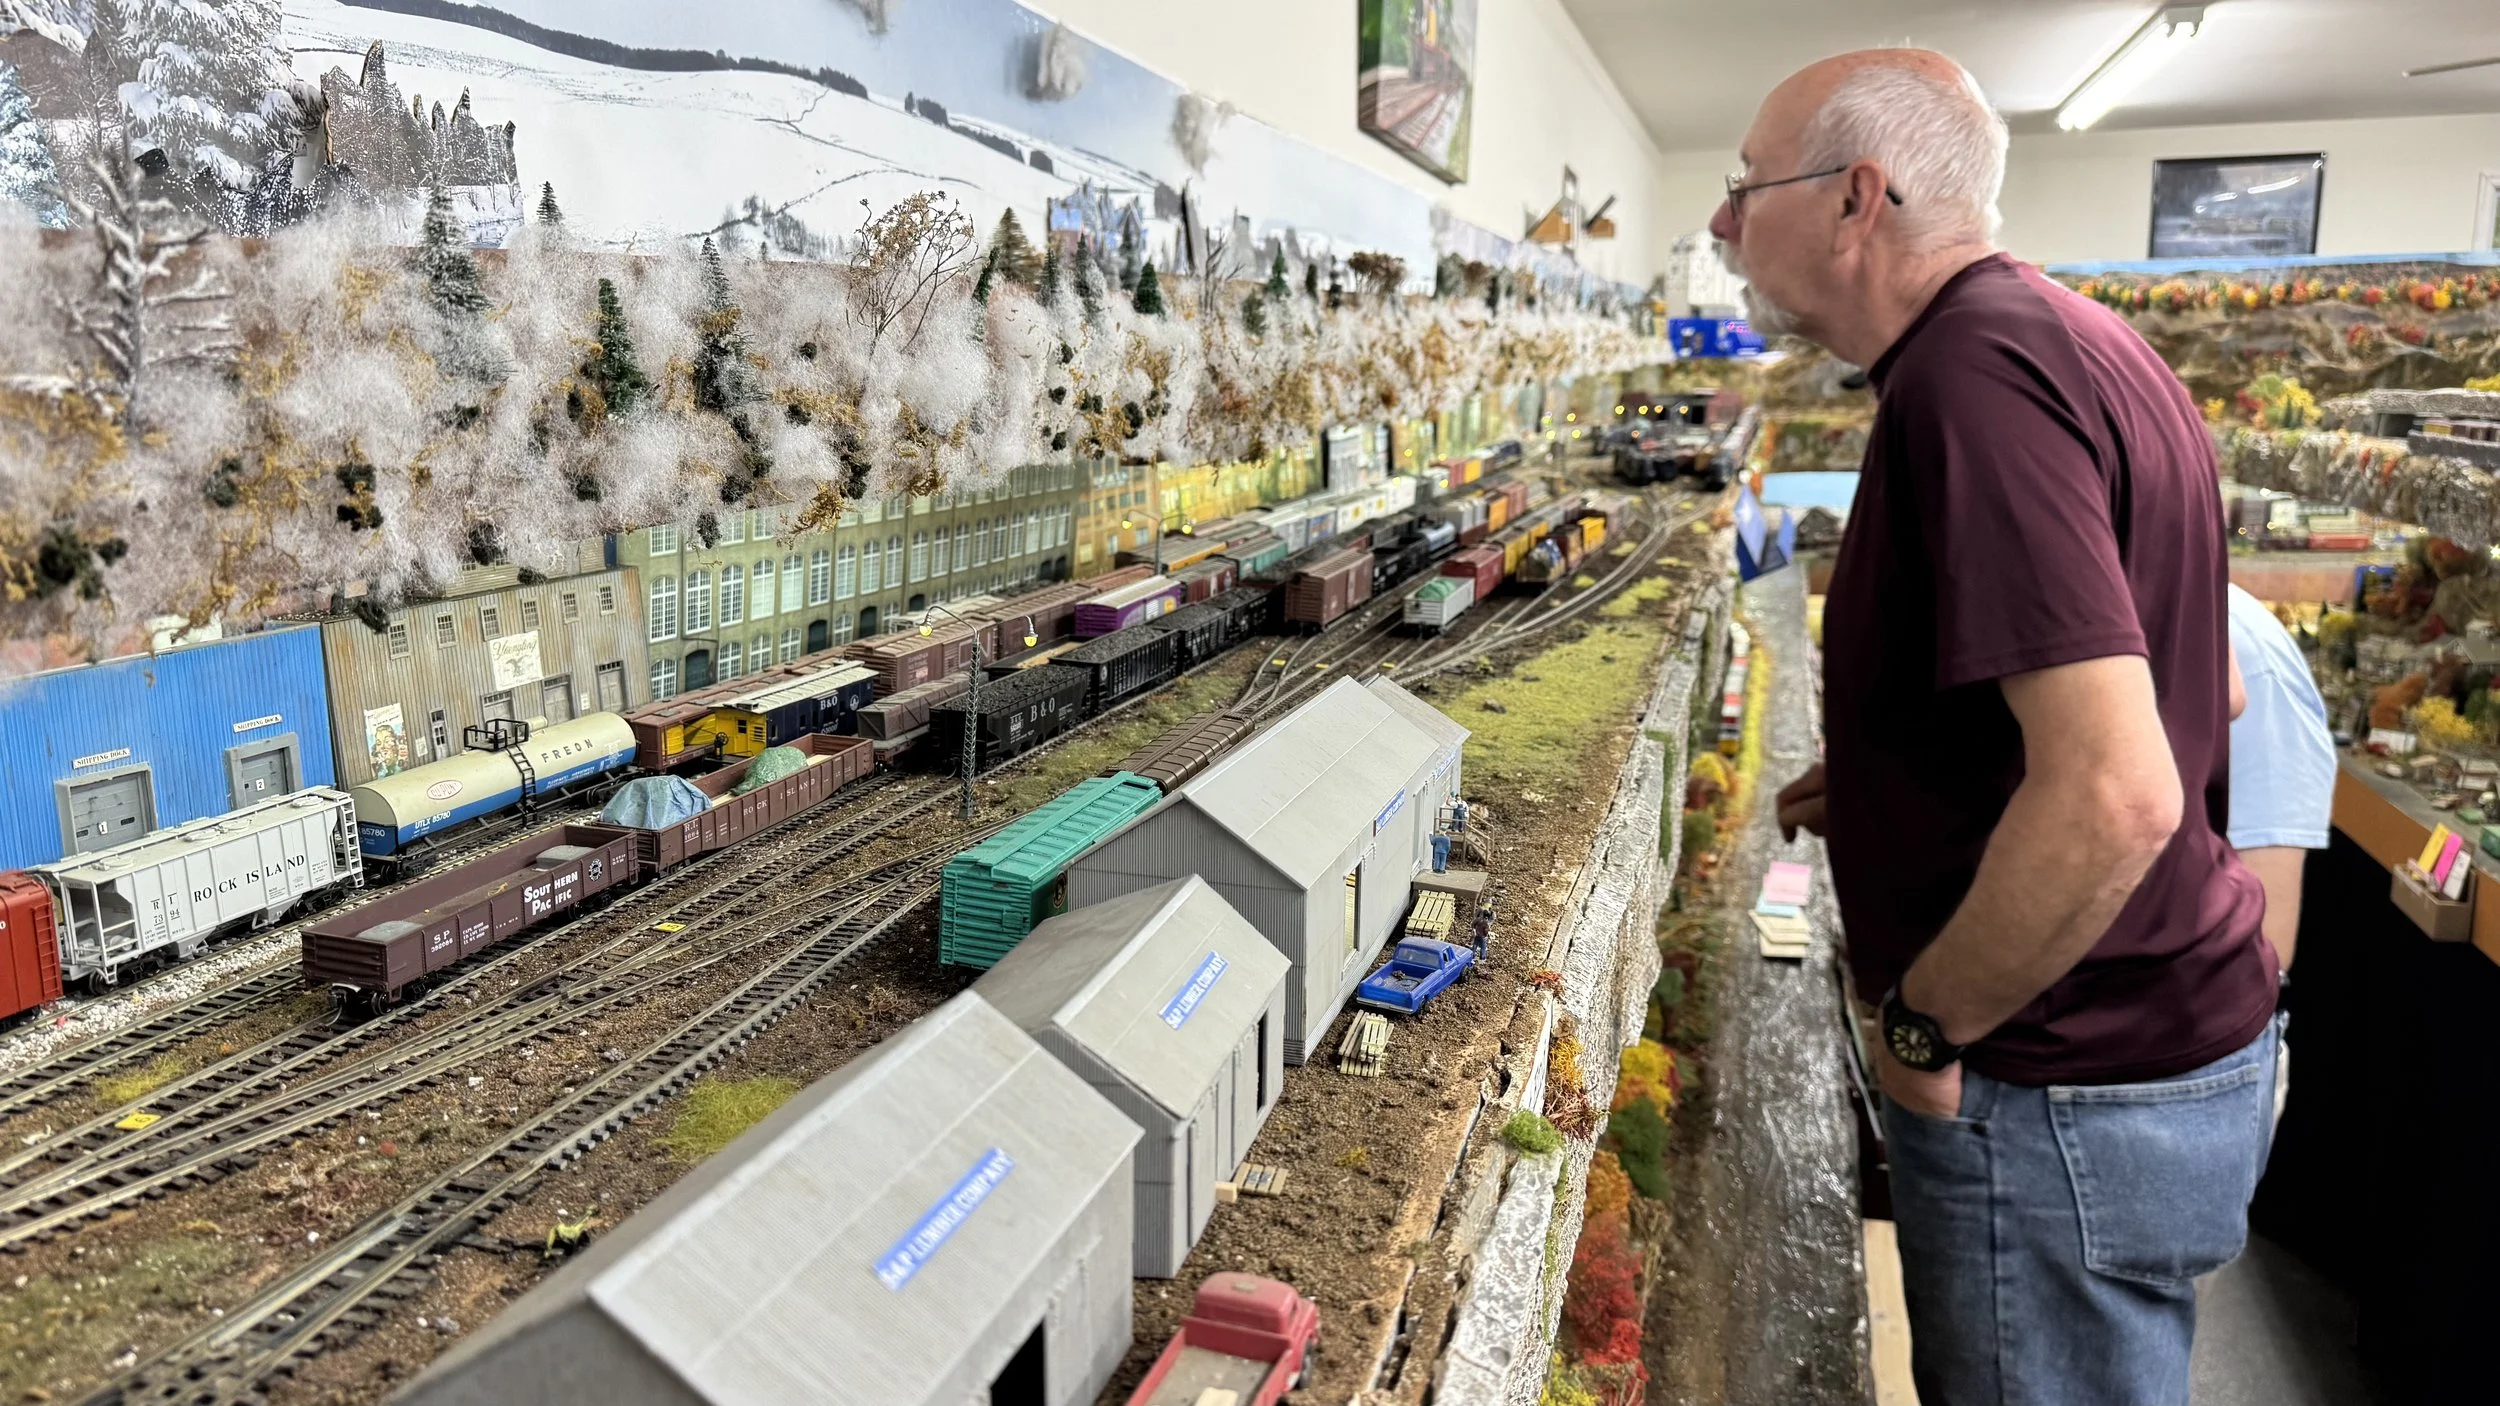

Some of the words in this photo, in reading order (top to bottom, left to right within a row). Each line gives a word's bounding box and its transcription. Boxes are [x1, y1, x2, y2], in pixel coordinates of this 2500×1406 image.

[237, 720, 264, 730] SHIPPING
[265, 716, 280, 724] DOCK
[77, 753, 109, 766] SHIPPING
[110, 749, 128, 758] DOCK
[541, 738, 594, 763] FREON
[743, 799, 768, 816] ROCK
[780, 777, 816, 800] ISLAND
[414, 818, 431, 830] UTLX
[432, 811, 451, 823] 85780
[193, 876, 238, 904] ROCK
[246, 854, 305, 884] ISLAND
[524, 871, 578, 903] SOUTHERN
[532, 888, 572, 916] PACIFIC
